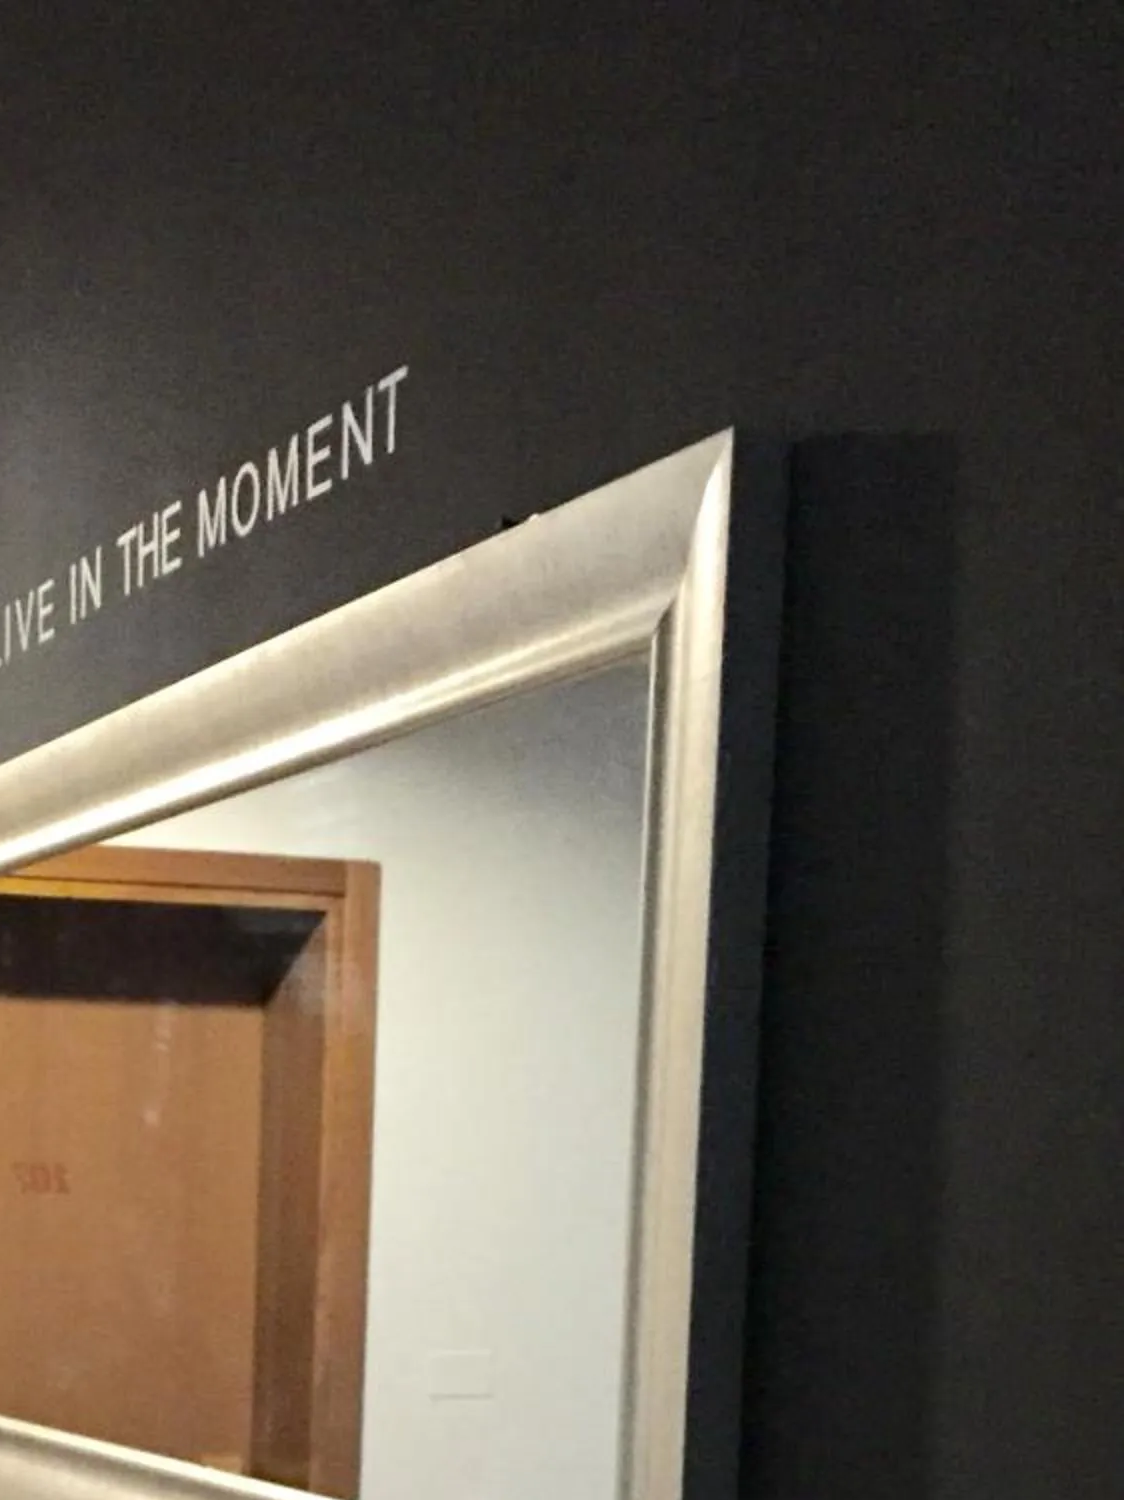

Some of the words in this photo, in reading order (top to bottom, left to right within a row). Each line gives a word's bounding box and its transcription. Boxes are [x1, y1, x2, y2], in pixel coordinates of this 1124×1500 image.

[69, 545, 103, 625] IN
[115, 499, 183, 597] THE
[197, 364, 410, 559] MOMENT
